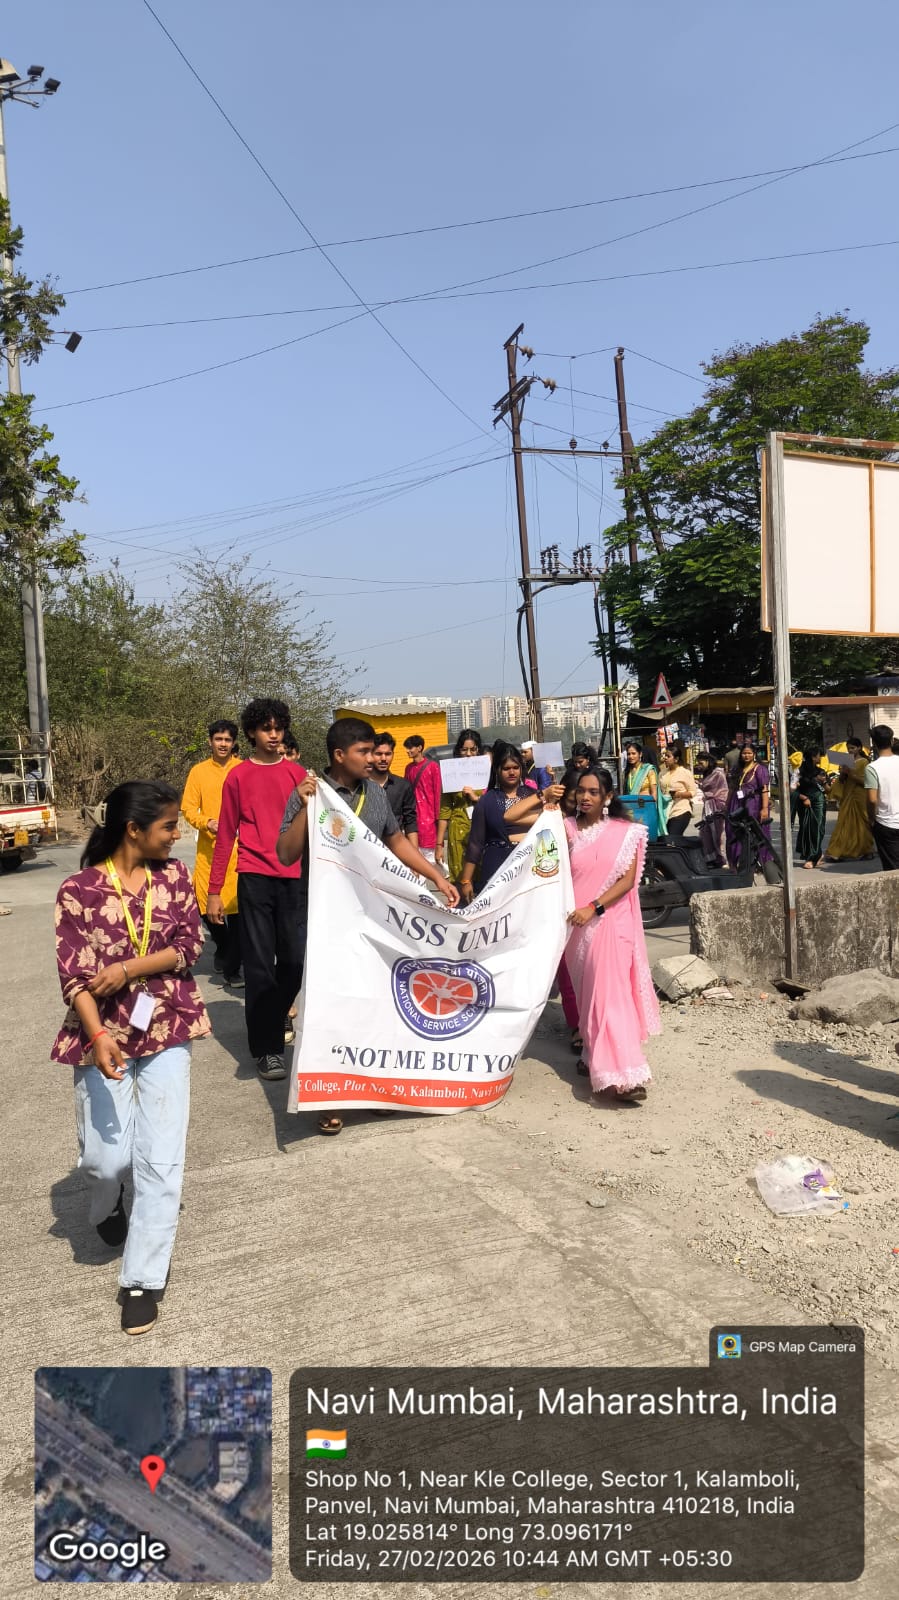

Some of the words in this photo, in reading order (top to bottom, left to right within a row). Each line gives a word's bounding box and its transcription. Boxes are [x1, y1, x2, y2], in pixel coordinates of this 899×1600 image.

[385, 904, 449, 947] NSS
[457, 907, 512, 954] UNIT
[399, 980, 422, 1025] NATIONAL
[422, 1018, 462, 1032] SERVICE
[393, 1049, 426, 1070] ME
[431, 1051, 479, 1073] BUT
[304, 1079, 341, 1095] College,
[343, 1079, 367, 1092] Plot
[369, 1082, 388, 1095] No.
[410, 1085, 468, 1100] Kalamboli,
